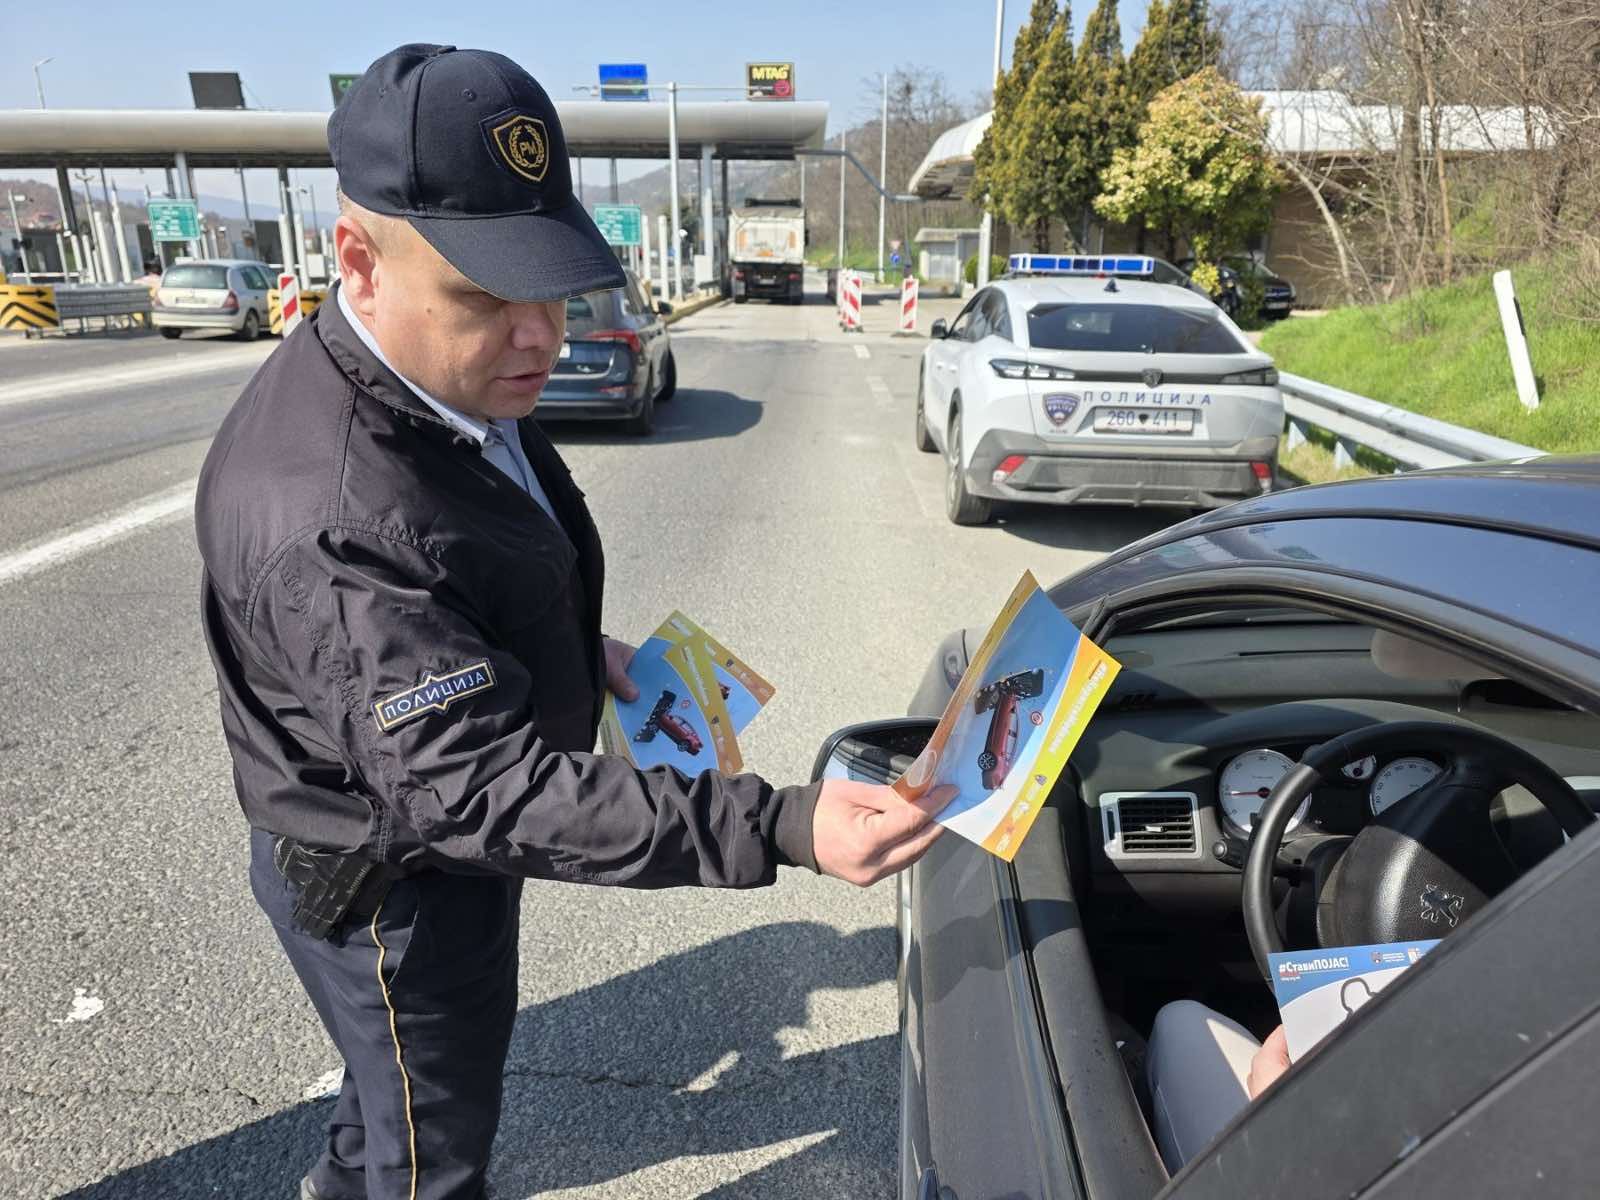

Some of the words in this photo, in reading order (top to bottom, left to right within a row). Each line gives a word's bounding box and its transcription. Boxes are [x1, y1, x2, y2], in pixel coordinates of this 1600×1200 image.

[1083, 391, 1212, 405] ПОЛИЦИЈА
[1107, 410, 1135, 426] 260
[1153, 411, 1178, 426] 411
[384, 671, 486, 719] ПОЛИЦИЈА
